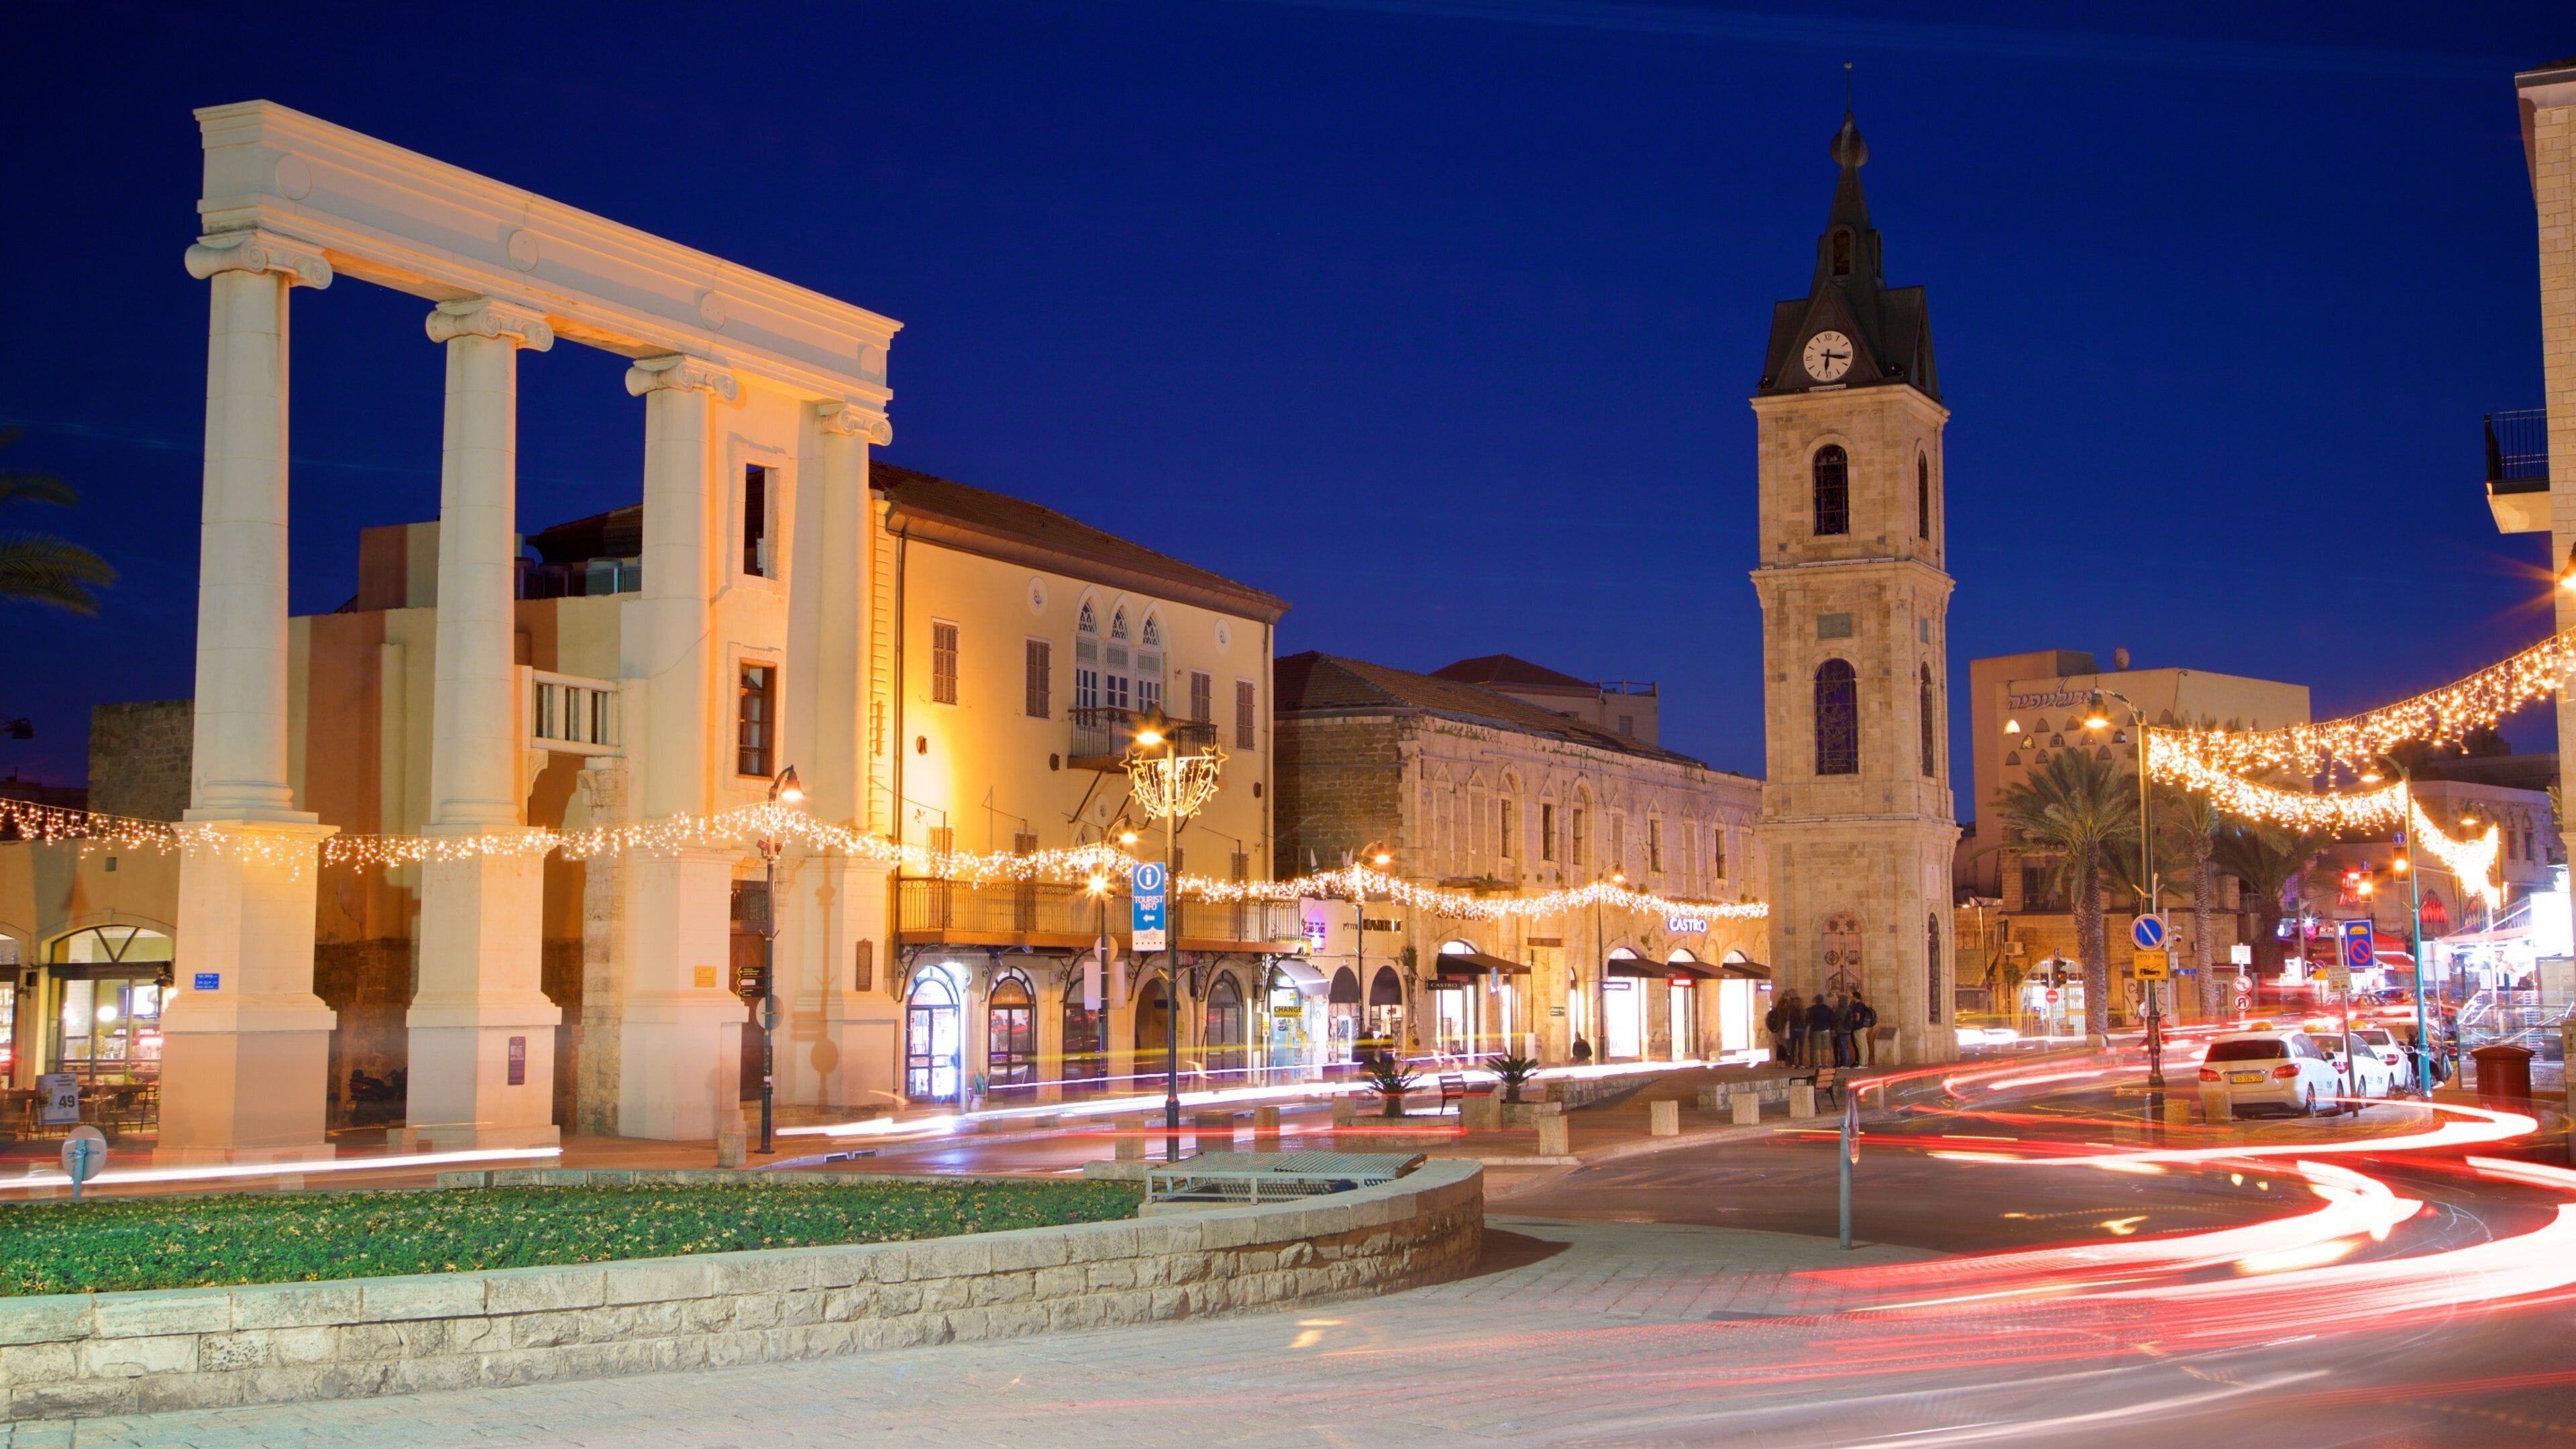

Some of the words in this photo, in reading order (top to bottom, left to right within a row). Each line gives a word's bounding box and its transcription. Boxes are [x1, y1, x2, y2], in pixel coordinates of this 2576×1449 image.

[1134, 895, 1164, 904] TOURIST
[1140, 903, 1157, 911] INFO
[1668, 917, 1707, 932] CASTRO
[58, 1095, 75, 1108] 49
